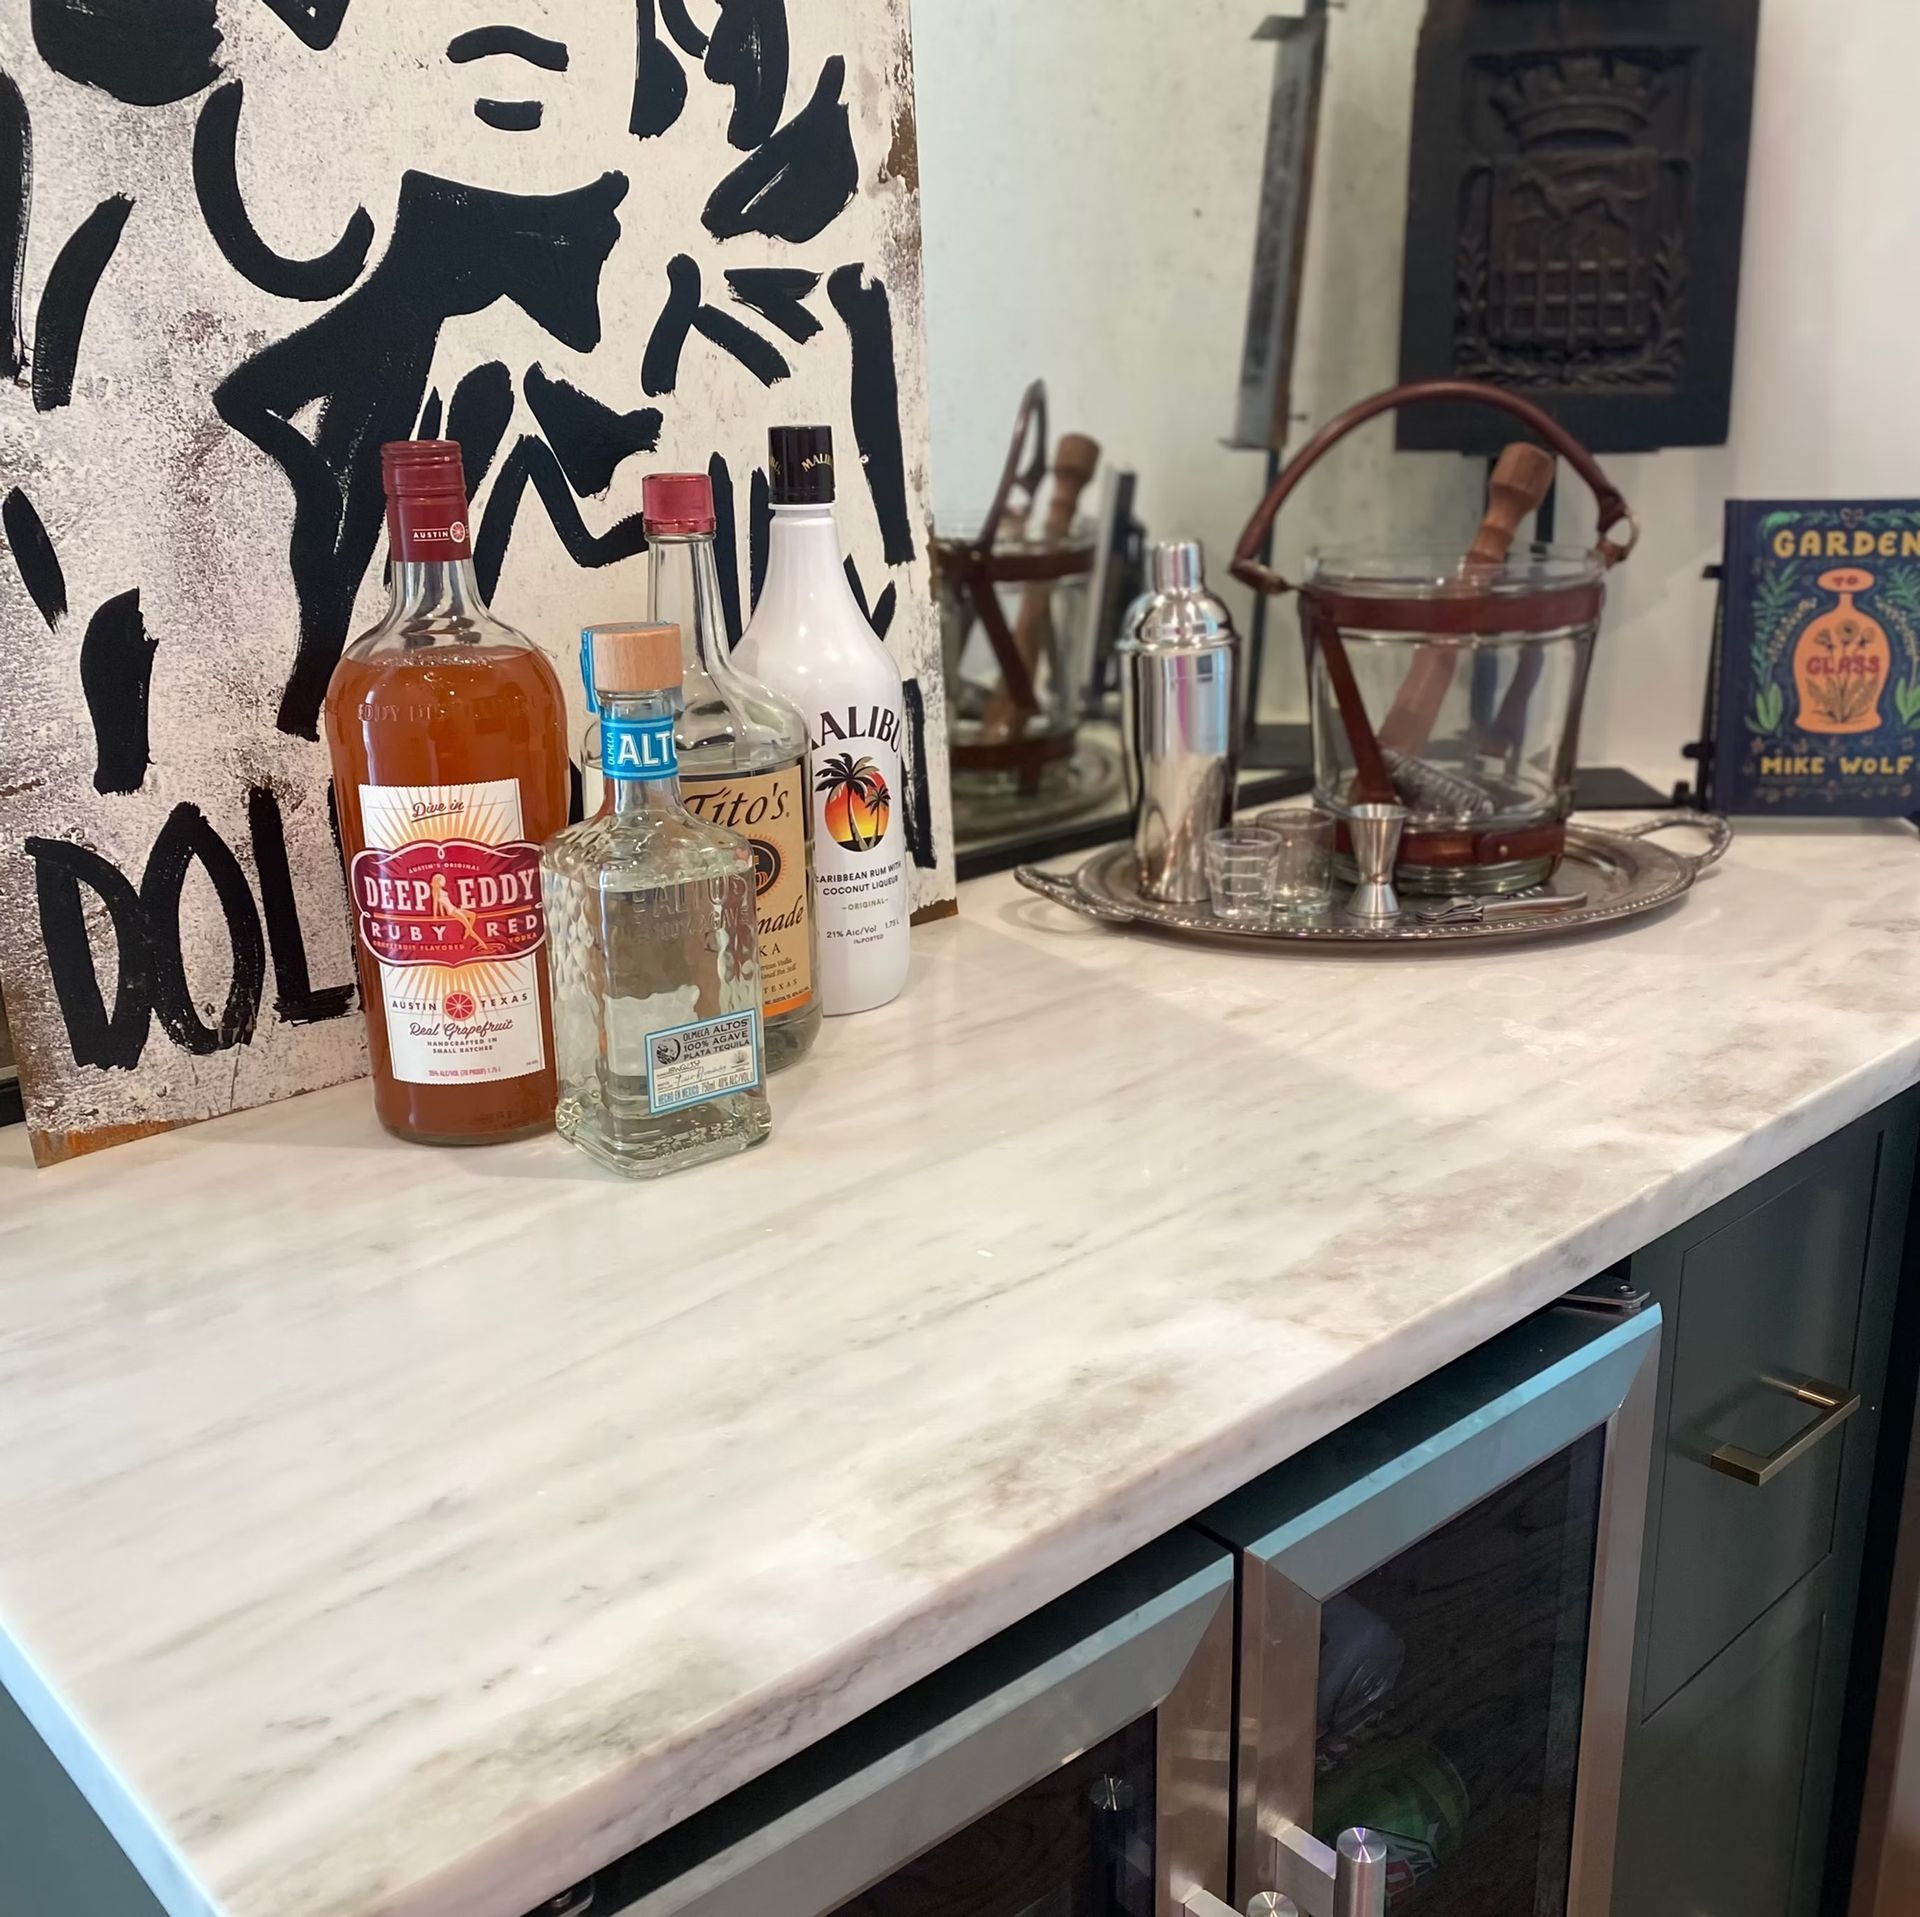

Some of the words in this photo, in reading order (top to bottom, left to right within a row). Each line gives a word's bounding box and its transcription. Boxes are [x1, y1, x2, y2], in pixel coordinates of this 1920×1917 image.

[413, 530, 449, 539] AUSTIN
[1773, 530, 1920, 558] GARDEN
[1832, 575, 1859, 587] TO
[1806, 655, 1880, 676] GLASS
[811, 705, 901, 753] ALIBU
[617, 730, 677, 767] ALT
[1761, 756, 1825, 775] MIKE
[1840, 755, 1913, 776] WOLF
[412, 801, 447, 818] Dive
[450, 799, 465, 810] in
[683, 782, 789, 828] Tito's
[444, 862, 480, 871] ORIGINAL
[869, 866, 887, 877] RUM
[887, 860, 902, 873] WITH
[363, 875, 431, 912] DEEP
[457, 868, 536, 910] EDDY
[823, 883, 870, 896] COCONUT
[871, 874, 899, 890] LIQUEUR
[24, 782, 358, 1071] DOL
[371, 921, 447, 941] RUBY
[486, 914, 538, 938] RED
[826, 930, 844, 939] 21%
[420, 943, 465, 952] FLAVORED
[763, 978, 798, 994] TEXAS
[392, 1000, 437, 1011] AUSTIN
[480, 992, 528, 1008] TEXAS
[409, 1022, 440, 1037] Real
[443, 1019, 514, 1040] Grapefruit
[683, 1027, 710, 1042] OLMECA
[713, 1019, 748, 1034] ALTOS
[427, 1038, 480, 1047] HANDCRAFTED
[683, 1041, 709, 1052] 100%
[712, 1030, 748, 1045] AGAVE
[683, 1049, 711, 1060] PLATA
[714, 1040, 750, 1053] TEQUILA
